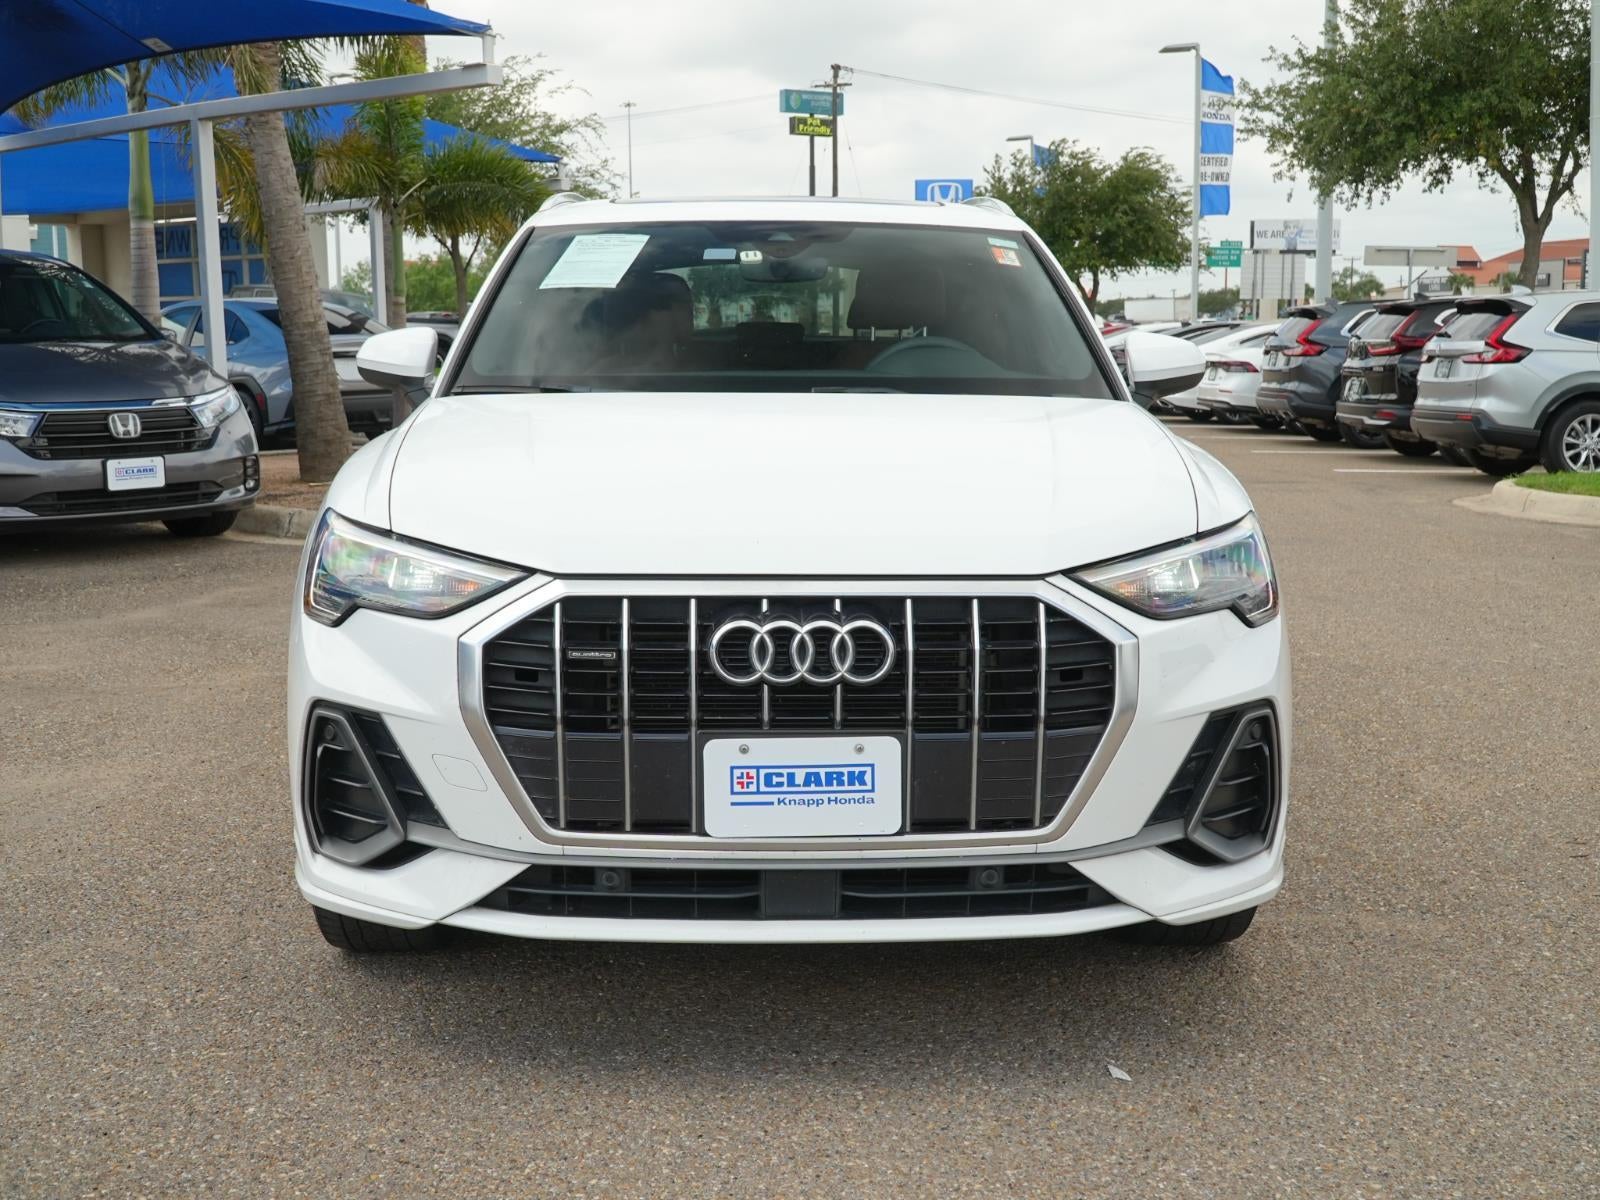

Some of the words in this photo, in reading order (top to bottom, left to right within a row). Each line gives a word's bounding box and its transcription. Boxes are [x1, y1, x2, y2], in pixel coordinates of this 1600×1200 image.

[807, 117, 821, 126] Pet
[799, 124, 831, 135] Friendly
[1256, 230, 1269, 239] WE
[763, 770, 868, 788] CLARK
[777, 796, 825, 807] Knapp
[827, 795, 875, 805] Honda
